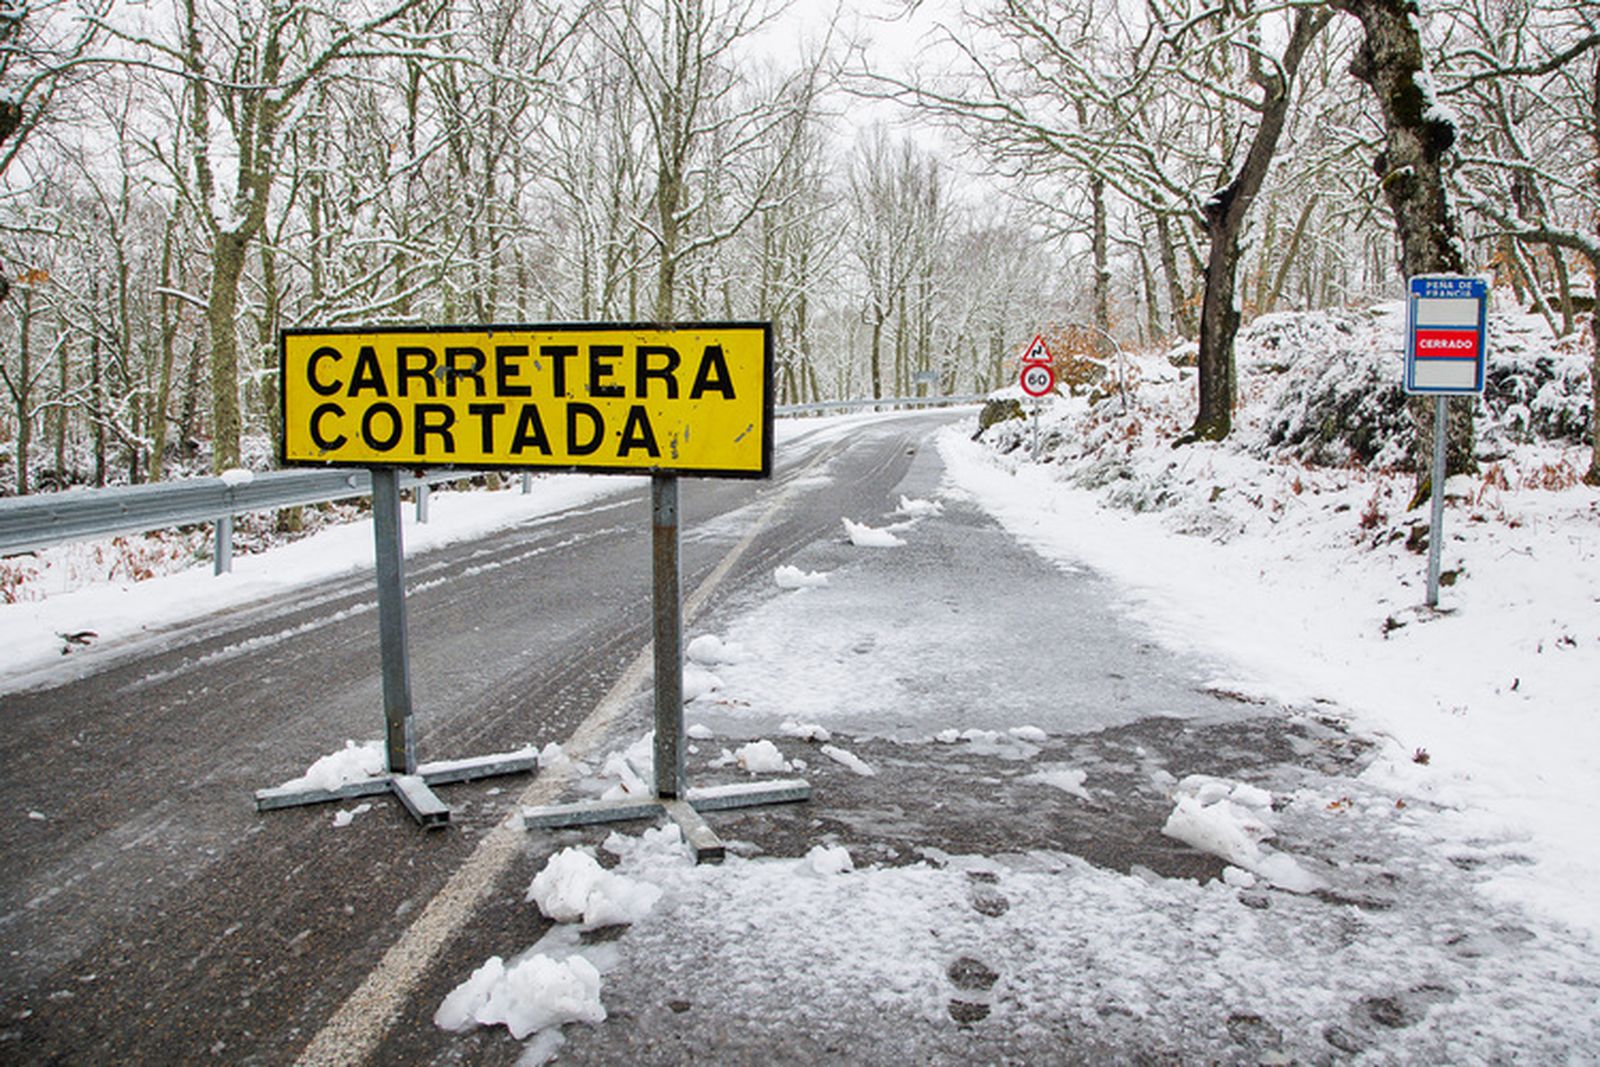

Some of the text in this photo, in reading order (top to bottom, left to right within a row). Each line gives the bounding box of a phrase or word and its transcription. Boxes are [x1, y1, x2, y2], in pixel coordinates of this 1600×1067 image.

[1458, 281, 1472, 289] DE
[1419, 338, 1473, 349] CERRADO
[305, 345, 737, 400] CARRETERA
[1028, 374, 1047, 386] 60
[309, 402, 660, 458] CORTADA
